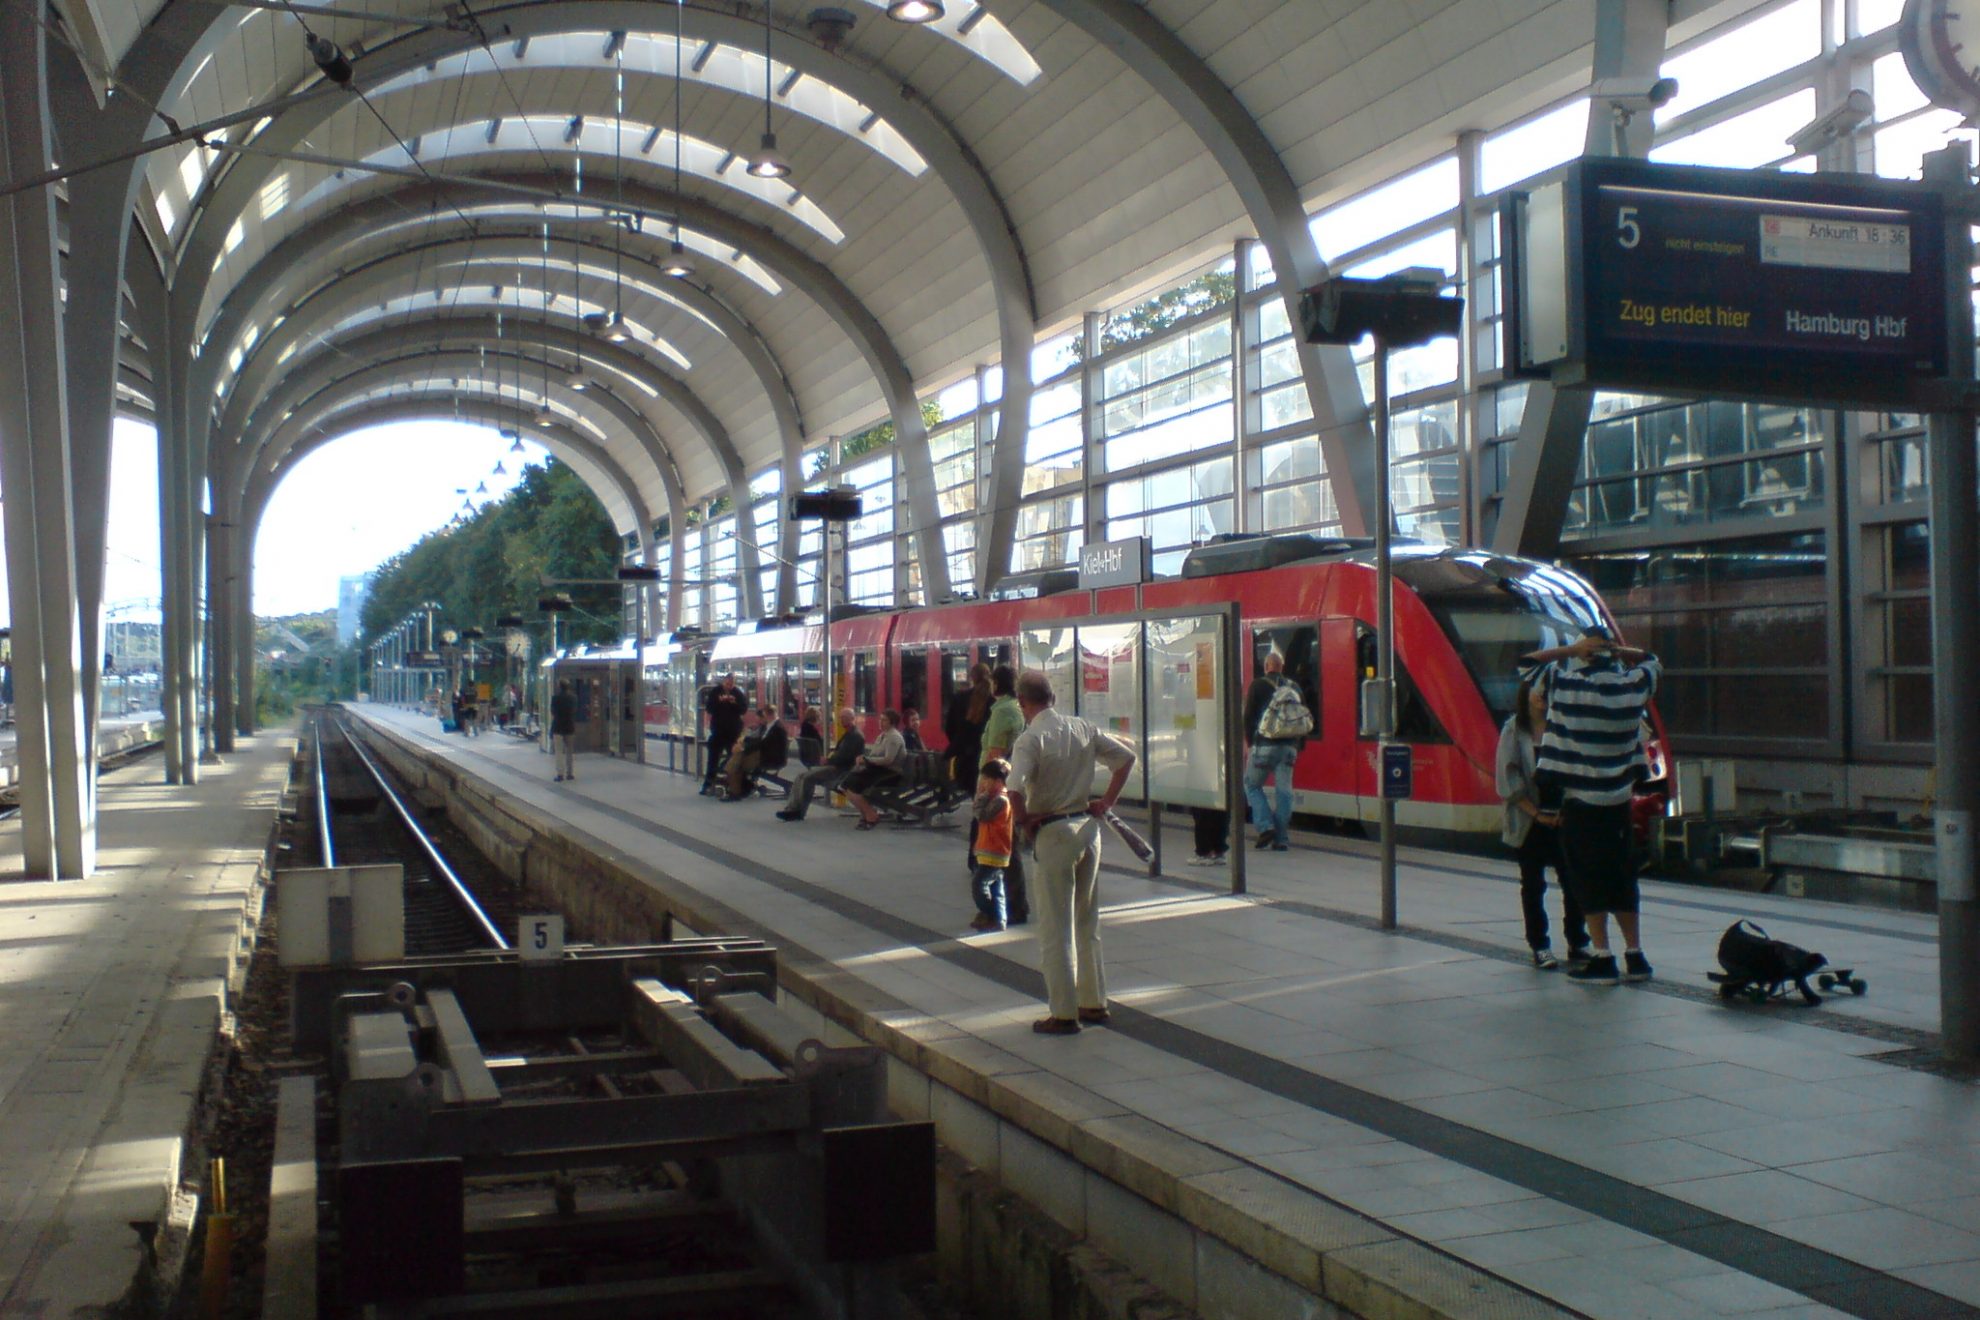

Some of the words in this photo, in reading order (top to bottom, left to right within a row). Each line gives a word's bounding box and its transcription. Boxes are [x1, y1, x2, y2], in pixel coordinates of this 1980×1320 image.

[1618, 206, 1641, 249] 5
[1809, 223, 1859, 241] Ankunft
[1620, 299, 1656, 327] Zug
[1661, 304, 1713, 326] endet
[1716, 306, 1751, 328] hier
[1785, 309, 1871, 340] Hamburg
[1874, 315, 1908, 338] Hbf
[1083, 549, 1101, 576] Kiel
[534, 922, 548, 950] 5
